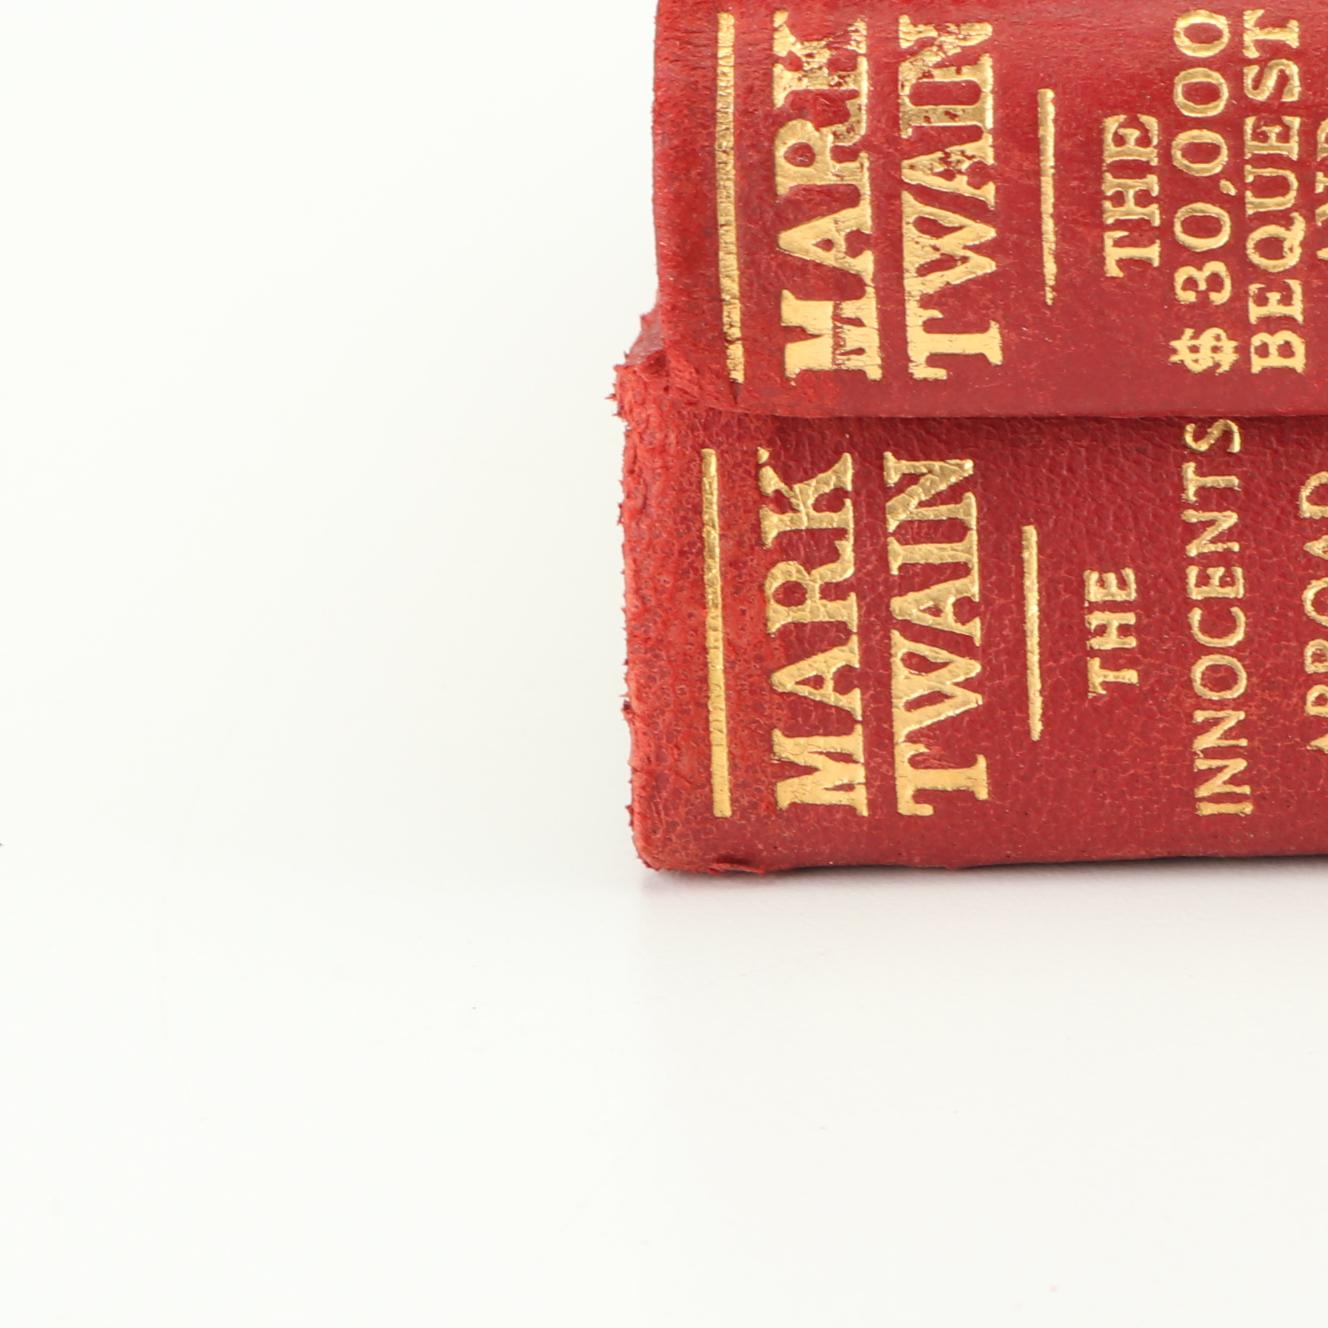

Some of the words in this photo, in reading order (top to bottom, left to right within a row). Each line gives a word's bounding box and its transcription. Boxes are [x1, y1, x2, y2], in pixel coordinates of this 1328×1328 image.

[772, 10, 882, 382] MARK
[899, 14, 1003, 381] TWAIN
[1103, 114, 1162, 279] THE
[1169, 10, 1240, 375] $30,000
[1243, 8, 1306, 375] BEQUEST
[758, 447, 869, 817] MARK
[884, 453, 988, 817] TWAIN
[1083, 566, 1140, 699] THE
[1184, 419, 1253, 817] INNOCENTS
